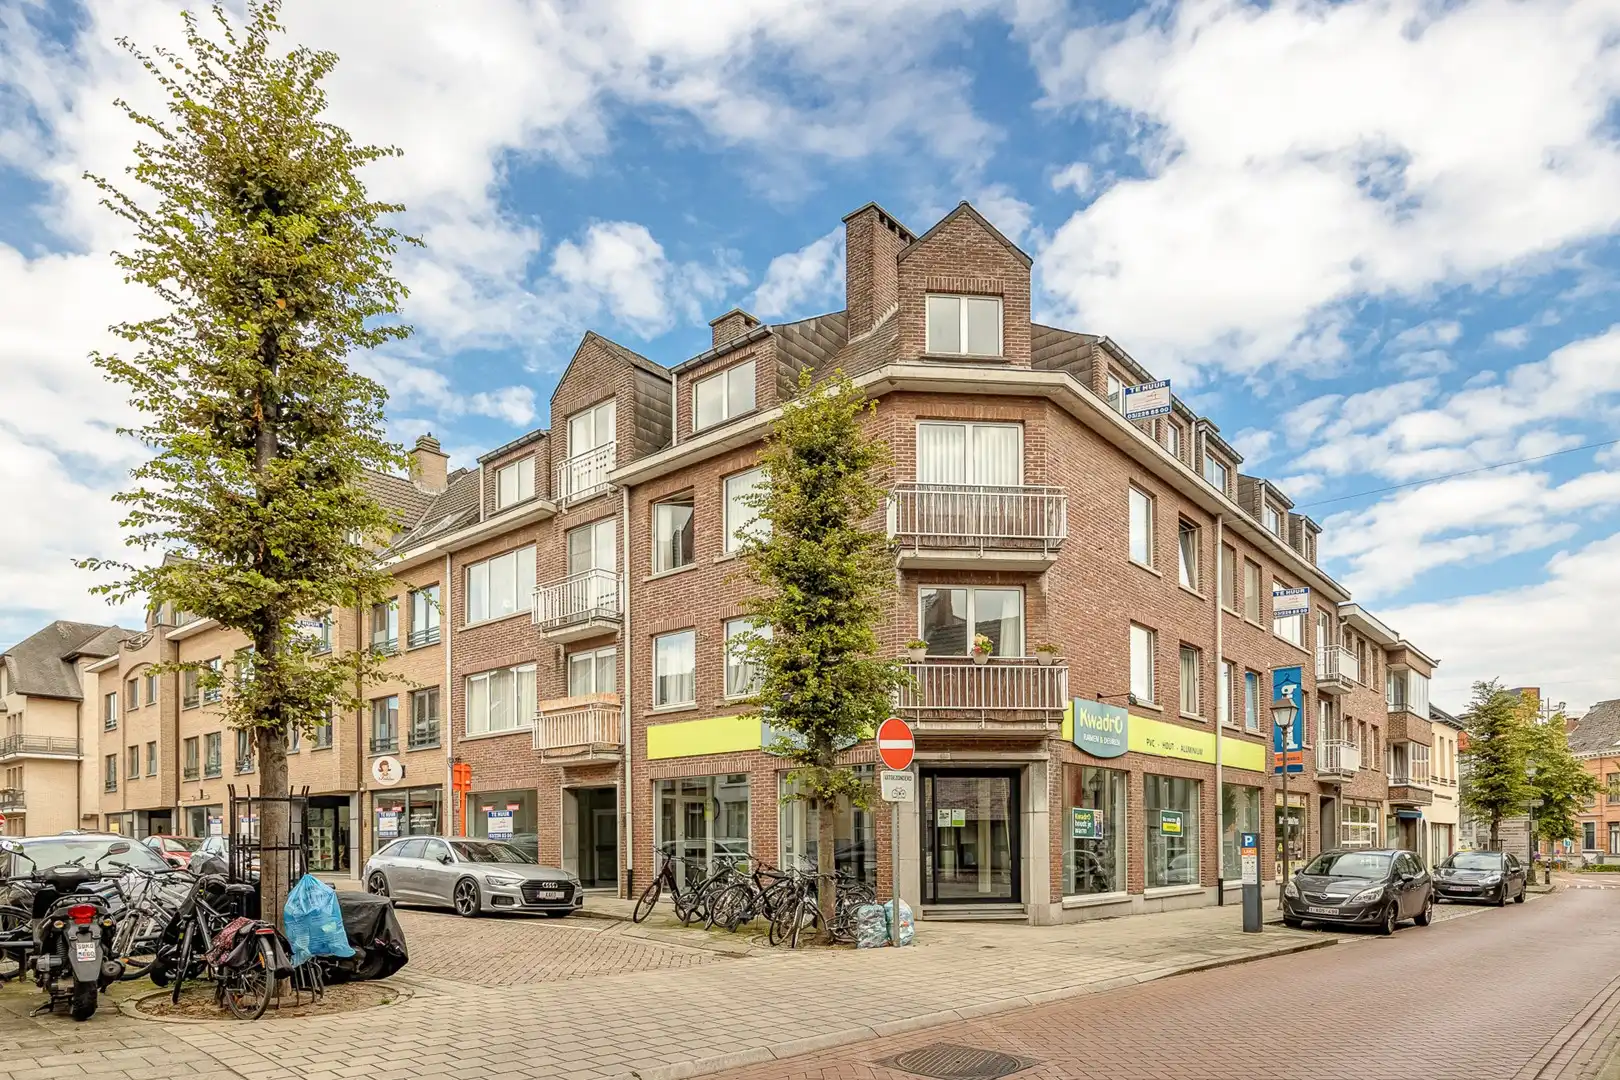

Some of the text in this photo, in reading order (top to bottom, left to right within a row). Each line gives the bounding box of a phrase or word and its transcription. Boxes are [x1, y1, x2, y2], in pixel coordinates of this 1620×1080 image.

[1142, 382, 1166, 391] HUUR
[1285, 587, 1304, 595] HUUR
[1083, 733, 1099, 743] RAMEN
[1103, 737, 1121, 746] DEUREN
[1146, 738, 1155, 747] PVC
[1162, 741, 1174, 750] HOUT
[1244, 835, 1253, 847] P
